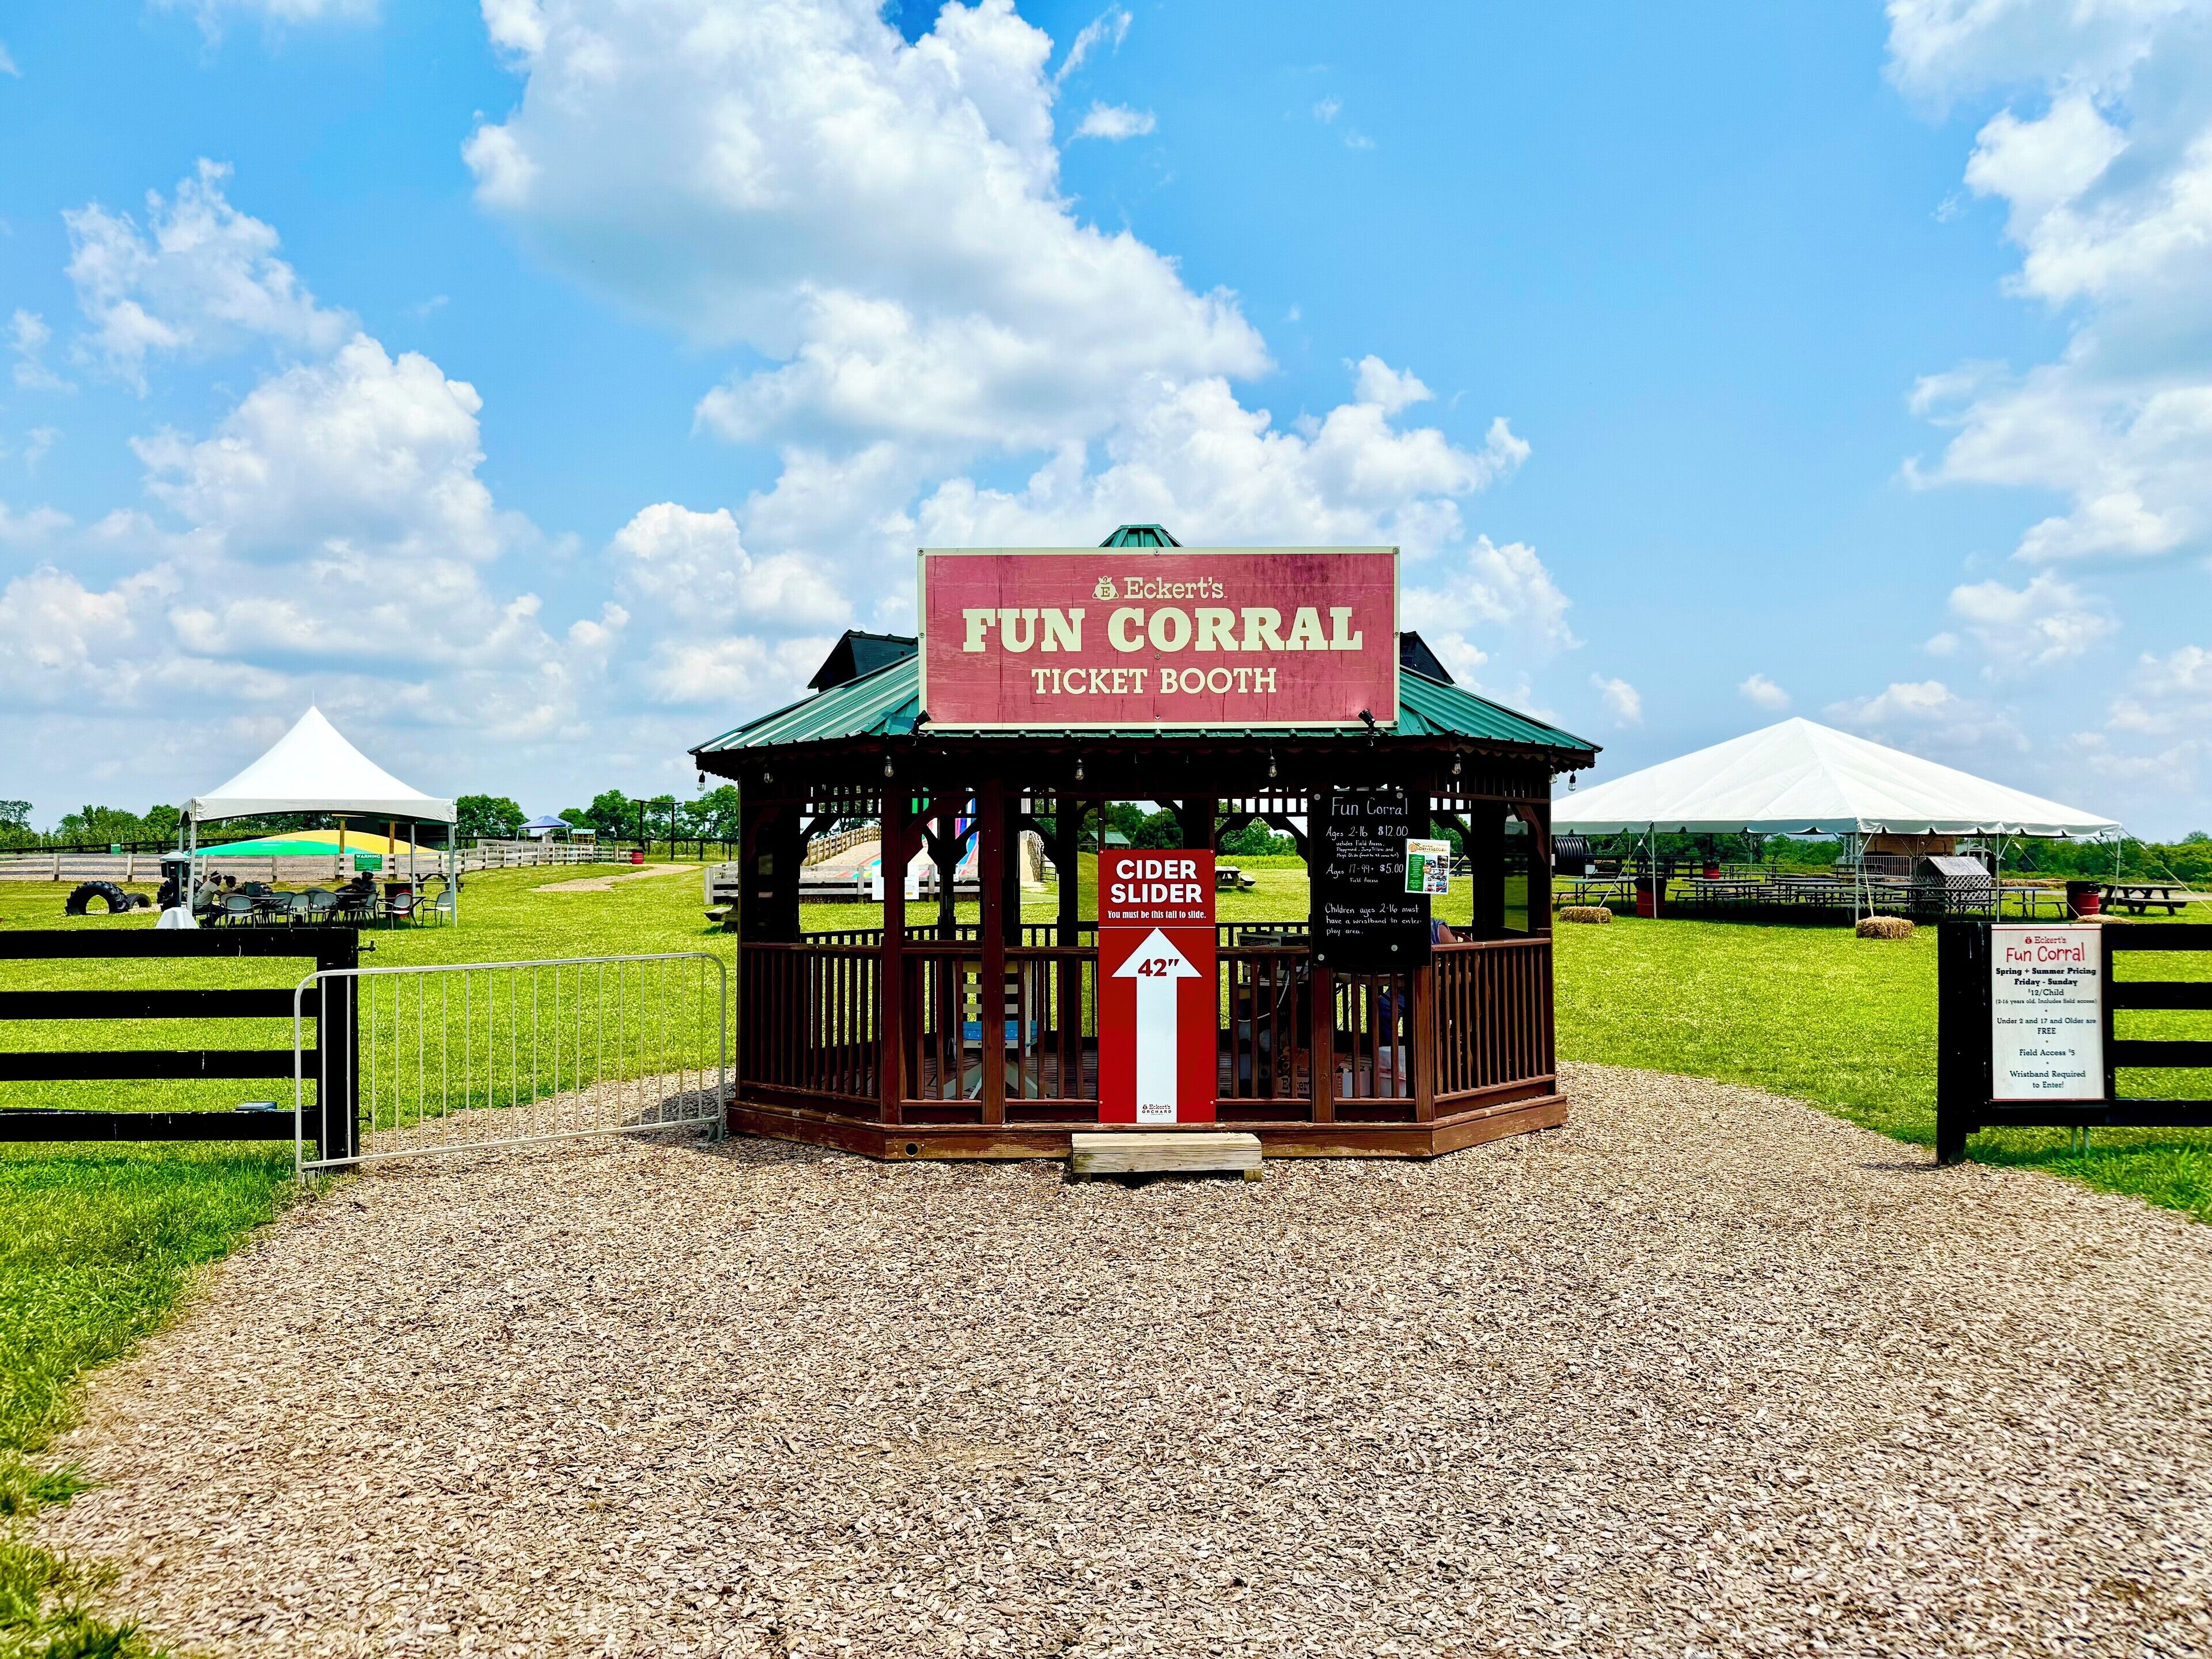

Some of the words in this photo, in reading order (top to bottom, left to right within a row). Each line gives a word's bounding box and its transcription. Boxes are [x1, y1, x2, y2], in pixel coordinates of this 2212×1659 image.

[1124, 577, 1224, 599] Eckert's
[962, 608, 1085, 653] FUN
[1107, 607, 1363, 652] CORRAL
[1032, 668, 1148, 695] TICKET
[1160, 667, 1277, 695] BOOTH
[1332, 797, 1358, 815] Fun
[1367, 797, 1407, 815] Corral
[1326, 826, 1343, 840] Ages
[1349, 826, 1368, 836] 2-16
[1378, 825, 1408, 836] $12.00
[1116, 859, 1197, 879] CIDER
[1326, 863, 1344, 878] Ages
[1380, 863, 1403, 873] $5.00
[1111, 884, 1203, 903] SLIDER
[1325, 903, 1354, 913] Children
[1360, 908, 1375, 917] ages
[1380, 903, 1397, 912] 2-16
[1402, 904, 1419, 912] must
[1327, 928, 1340, 936] play
[2006, 948, 2031, 962] Fun
[2037, 942, 2085, 962] Corral
[1996, 968, 2022, 976] Spring
[2048, 978, 2078, 986] Sunday
[2052, 1070, 2086, 1078] Required
